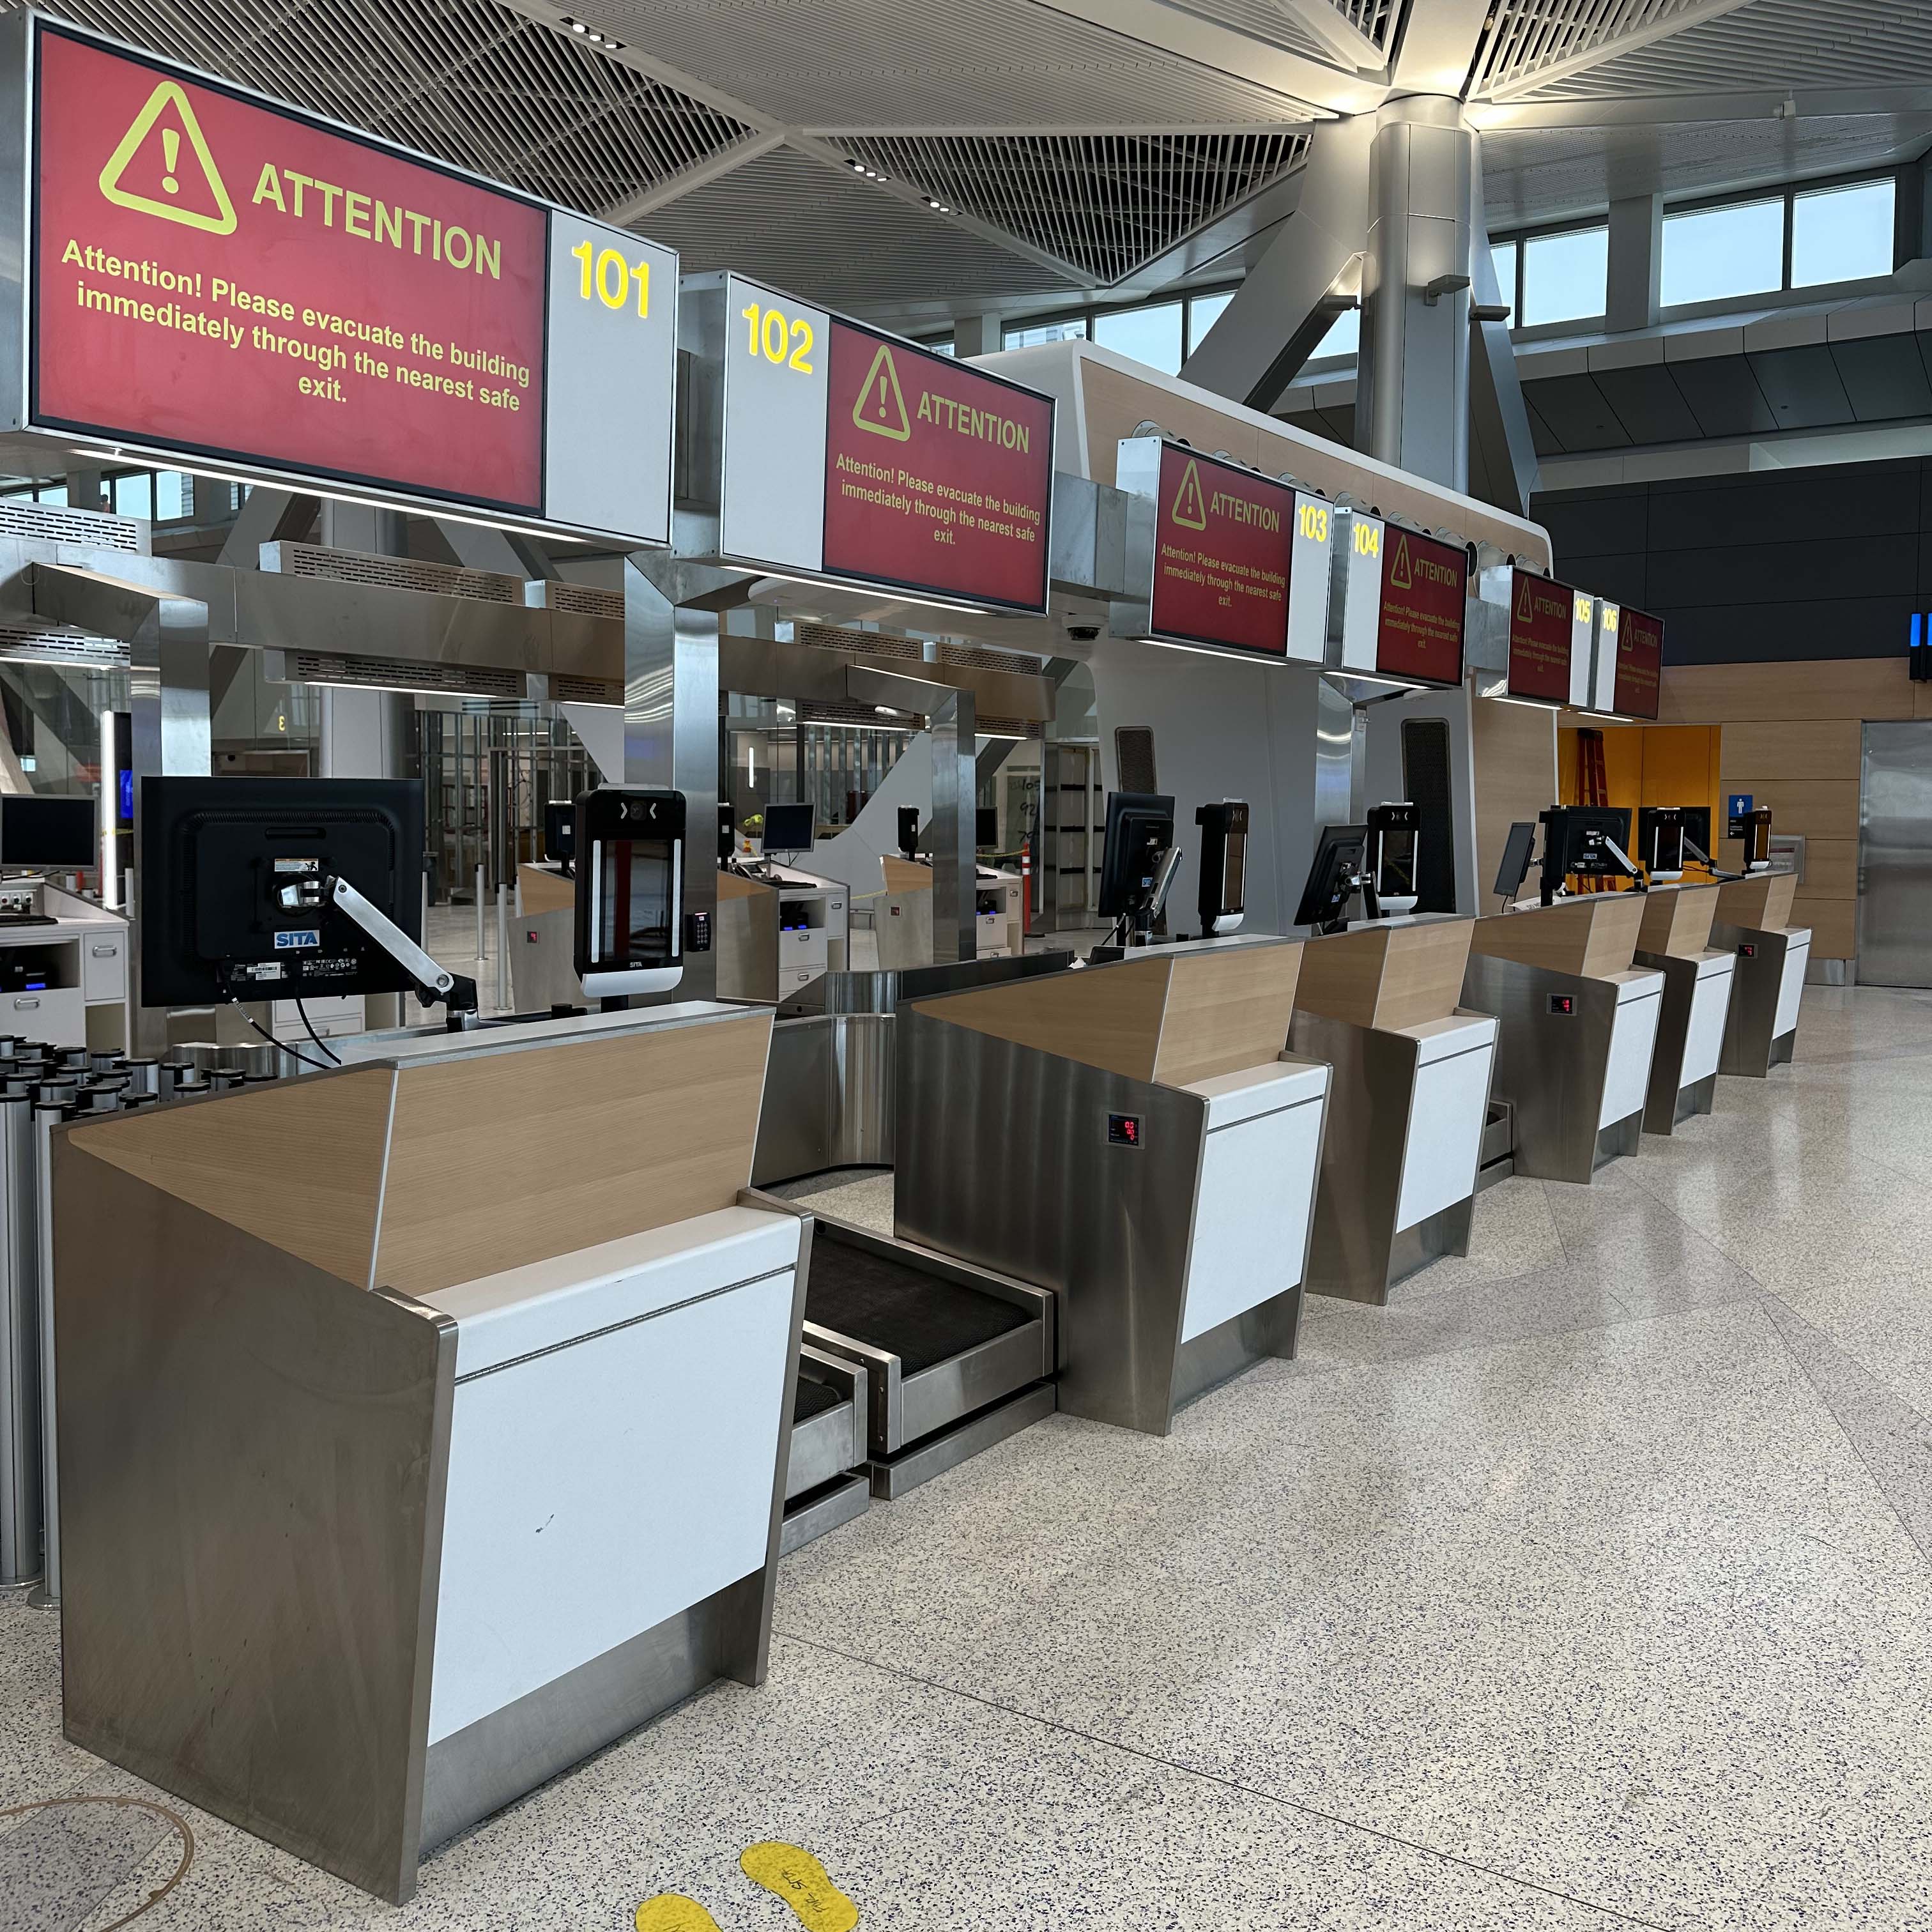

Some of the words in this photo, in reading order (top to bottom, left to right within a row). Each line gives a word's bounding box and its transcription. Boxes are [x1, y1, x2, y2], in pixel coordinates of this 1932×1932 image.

[253, 164, 501, 280] ATTENTION
[572, 240, 649, 318] 101
[62, 240, 201, 298] Attention!
[212, 279, 295, 321] Please
[302, 309, 404, 349] evacuate
[411, 332, 443, 360] the
[450, 344, 530, 387] building
[77, 281, 245, 349] immediately
[252, 327, 346, 371] through
[355, 351, 388, 379] the
[396, 367, 473, 401] nearest
[480, 385, 520, 411] safe
[742, 303, 813, 374] 102
[298, 375, 347, 402] exit.
[917, 391, 1029, 454] ATTENTION
[836, 453, 894, 483] Attention!
[898, 470, 934, 494] Please
[937, 483, 982, 507] evacuate
[985, 494, 1000, 512] the
[1003, 499, 1040, 526] building
[841, 479, 912, 515] immediately
[915, 499, 956, 525] through
[959, 510, 975, 527] the
[978, 517, 1013, 537] nearest
[1016, 527, 1035, 542] safe
[1210, 491, 1280, 533] ATTENTION
[1299, 504, 1327, 542] 103
[934, 528, 956, 544] exit.
[1354, 523, 1379, 558] 104
[1161, 543, 1196, 563] Attention!
[1197, 553, 1220, 569] Please
[1221, 562, 1249, 576] evacuate
[1250, 567, 1261, 578] the
[1261, 569, 1285, 588] building
[1164, 562, 1206, 586] immediately
[1207, 573, 1232, 592] through
[1234, 581, 1244, 592] the
[1246, 585, 1268, 599] nearest
[1269, 591, 1282, 601] safe
[1414, 558, 1457, 588] ATTENTION
[1218, 595, 1232, 607] exit.
[1534, 596, 1566, 619] ATTENTION
[1575, 598, 1591, 624] 105
[1603, 608, 1617, 632] 106
[1634, 629, 1657, 648] ATTENTION
[276, 931, 318, 946] SITA
